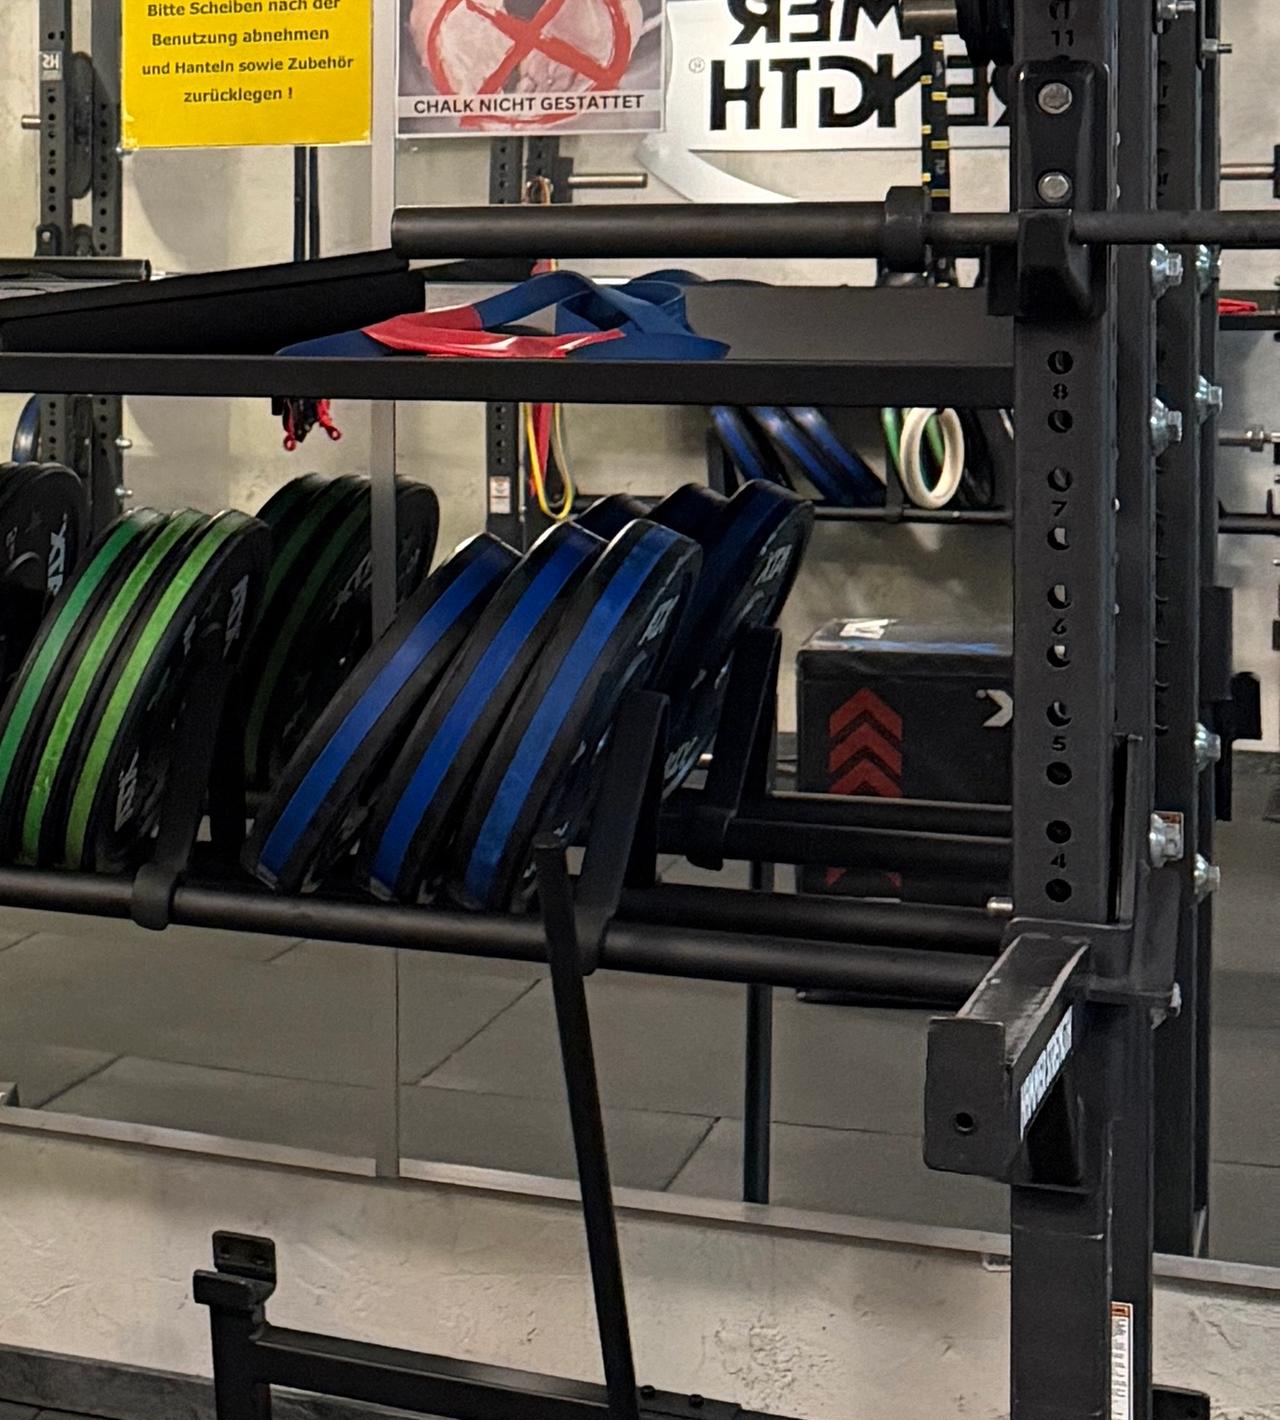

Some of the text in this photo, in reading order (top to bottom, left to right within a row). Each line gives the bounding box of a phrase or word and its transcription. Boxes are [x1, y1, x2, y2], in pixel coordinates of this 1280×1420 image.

[147, 0, 341, 17] Bitte Scheiben nach der
[151, 28, 329, 47] Benutzung abnehmen
[142, 56, 354, 76] und Hanteln sowie Zubehör
[183, 88, 283, 104] zurücklegen
[414, 94, 645, 115] CHALK NICHT GESTATTET
